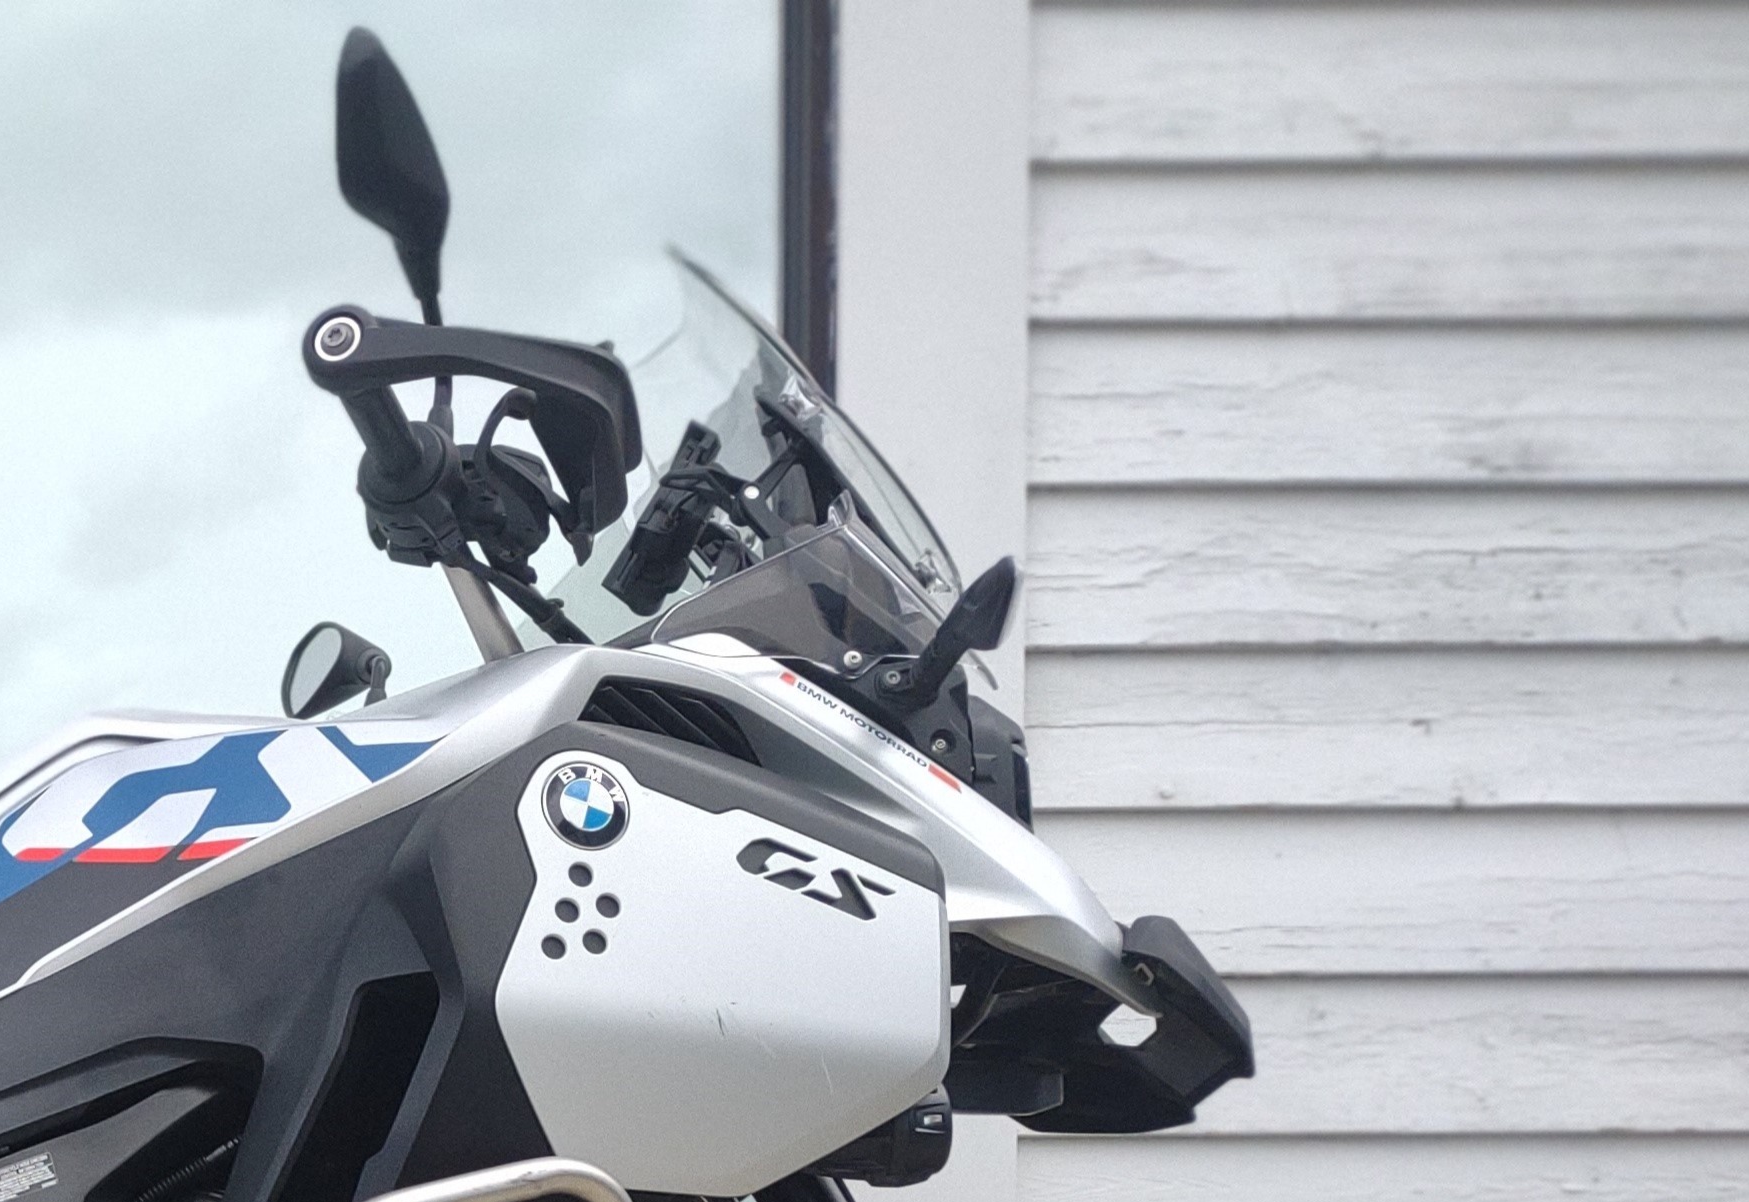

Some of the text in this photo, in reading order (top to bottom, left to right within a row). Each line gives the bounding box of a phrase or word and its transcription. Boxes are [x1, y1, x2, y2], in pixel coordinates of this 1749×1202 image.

[796, 680, 928, 769] BMW MOTORRAD
[557, 767, 626, 803] BMW
[735, 836, 897, 922] GS
